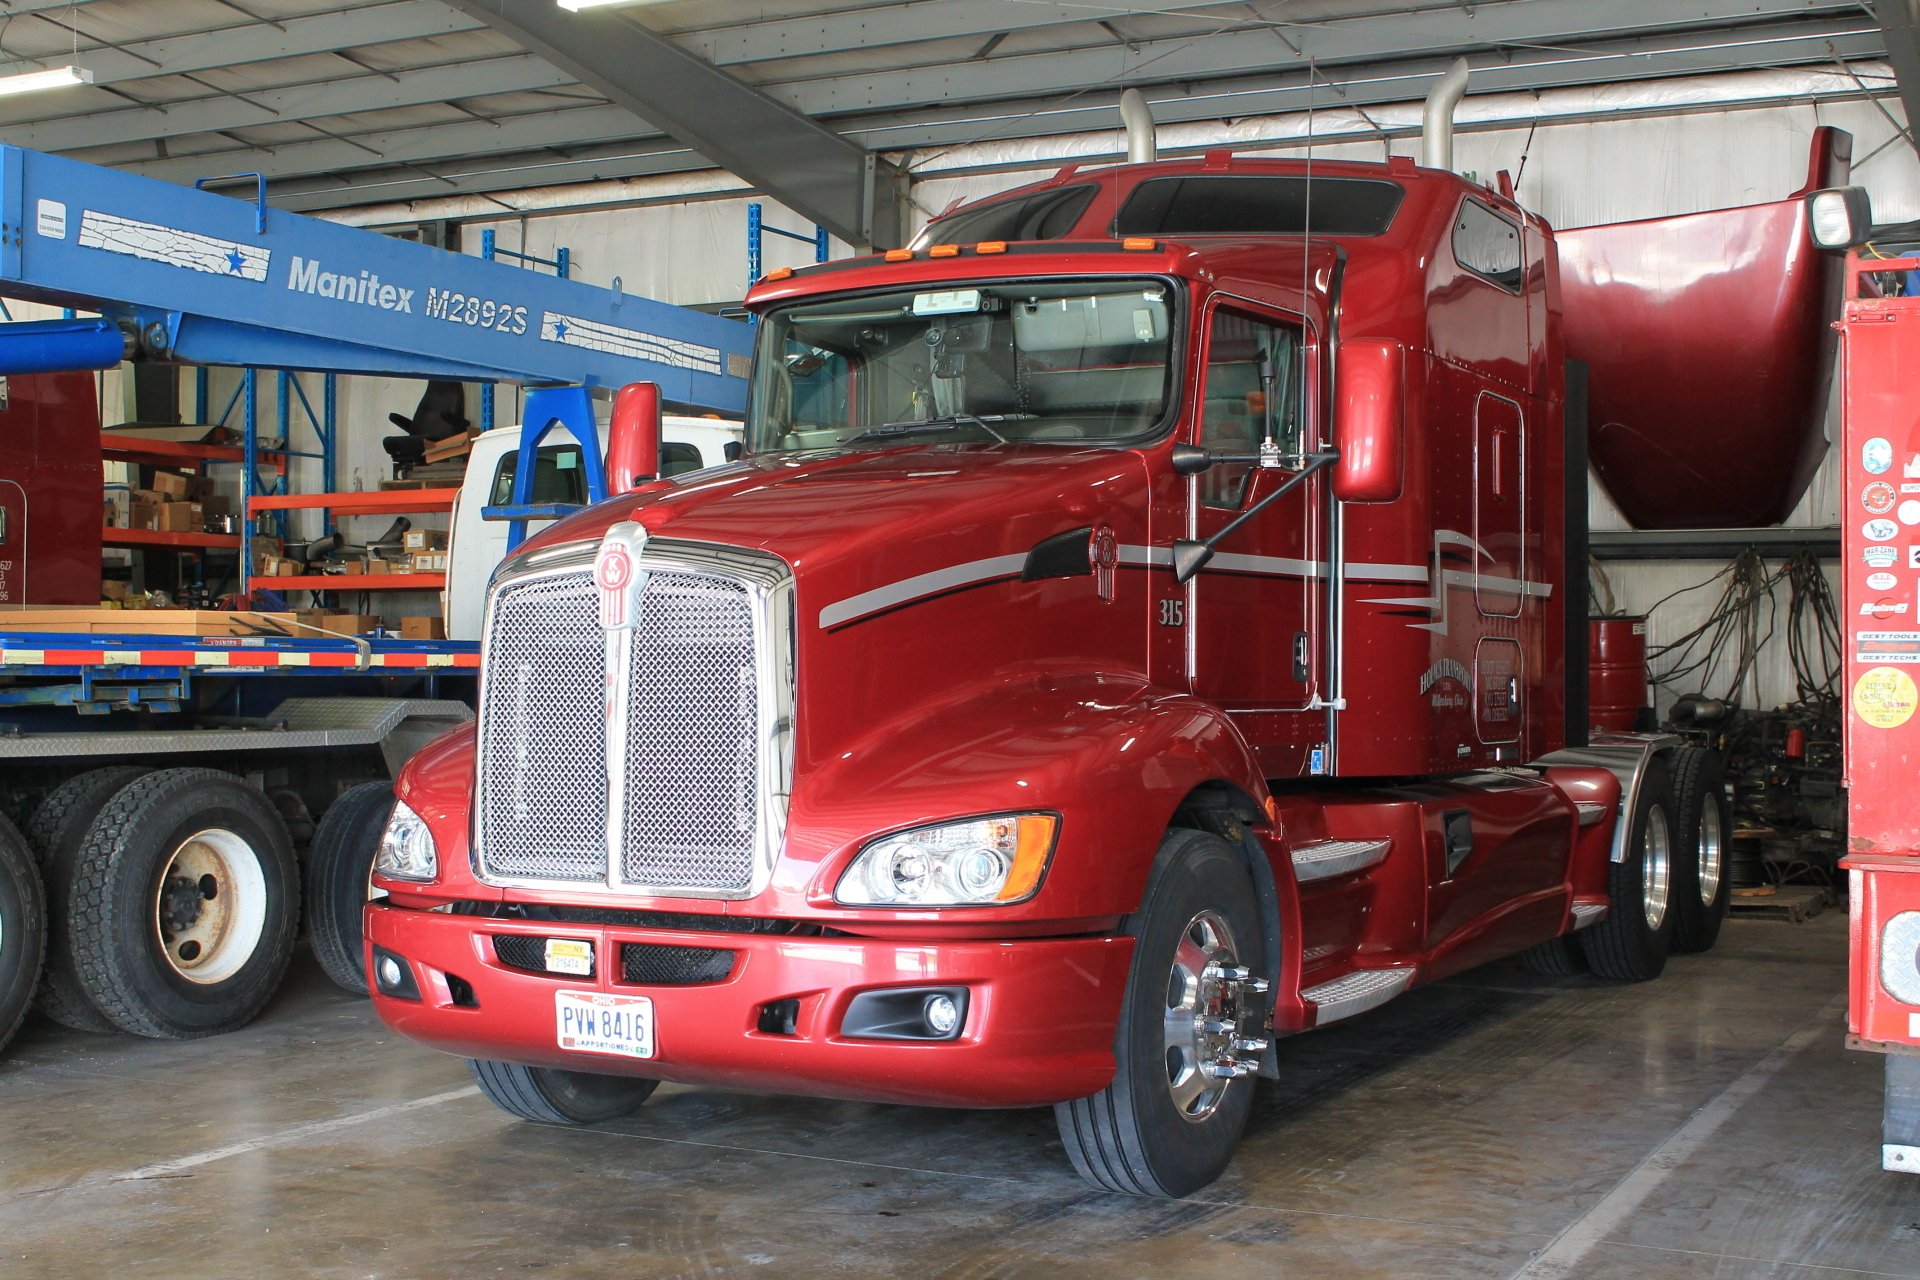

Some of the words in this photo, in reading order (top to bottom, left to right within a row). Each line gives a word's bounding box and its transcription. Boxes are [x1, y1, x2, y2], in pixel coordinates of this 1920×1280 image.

[288, 256, 415, 314] Manitex
[425, 287, 529, 336] M2892S
[1159, 599, 1183, 626] 315
[592, 995, 616, 1006] OHIO
[563, 1006, 596, 1037] PVW
[601, 1010, 645, 1042] 8416
